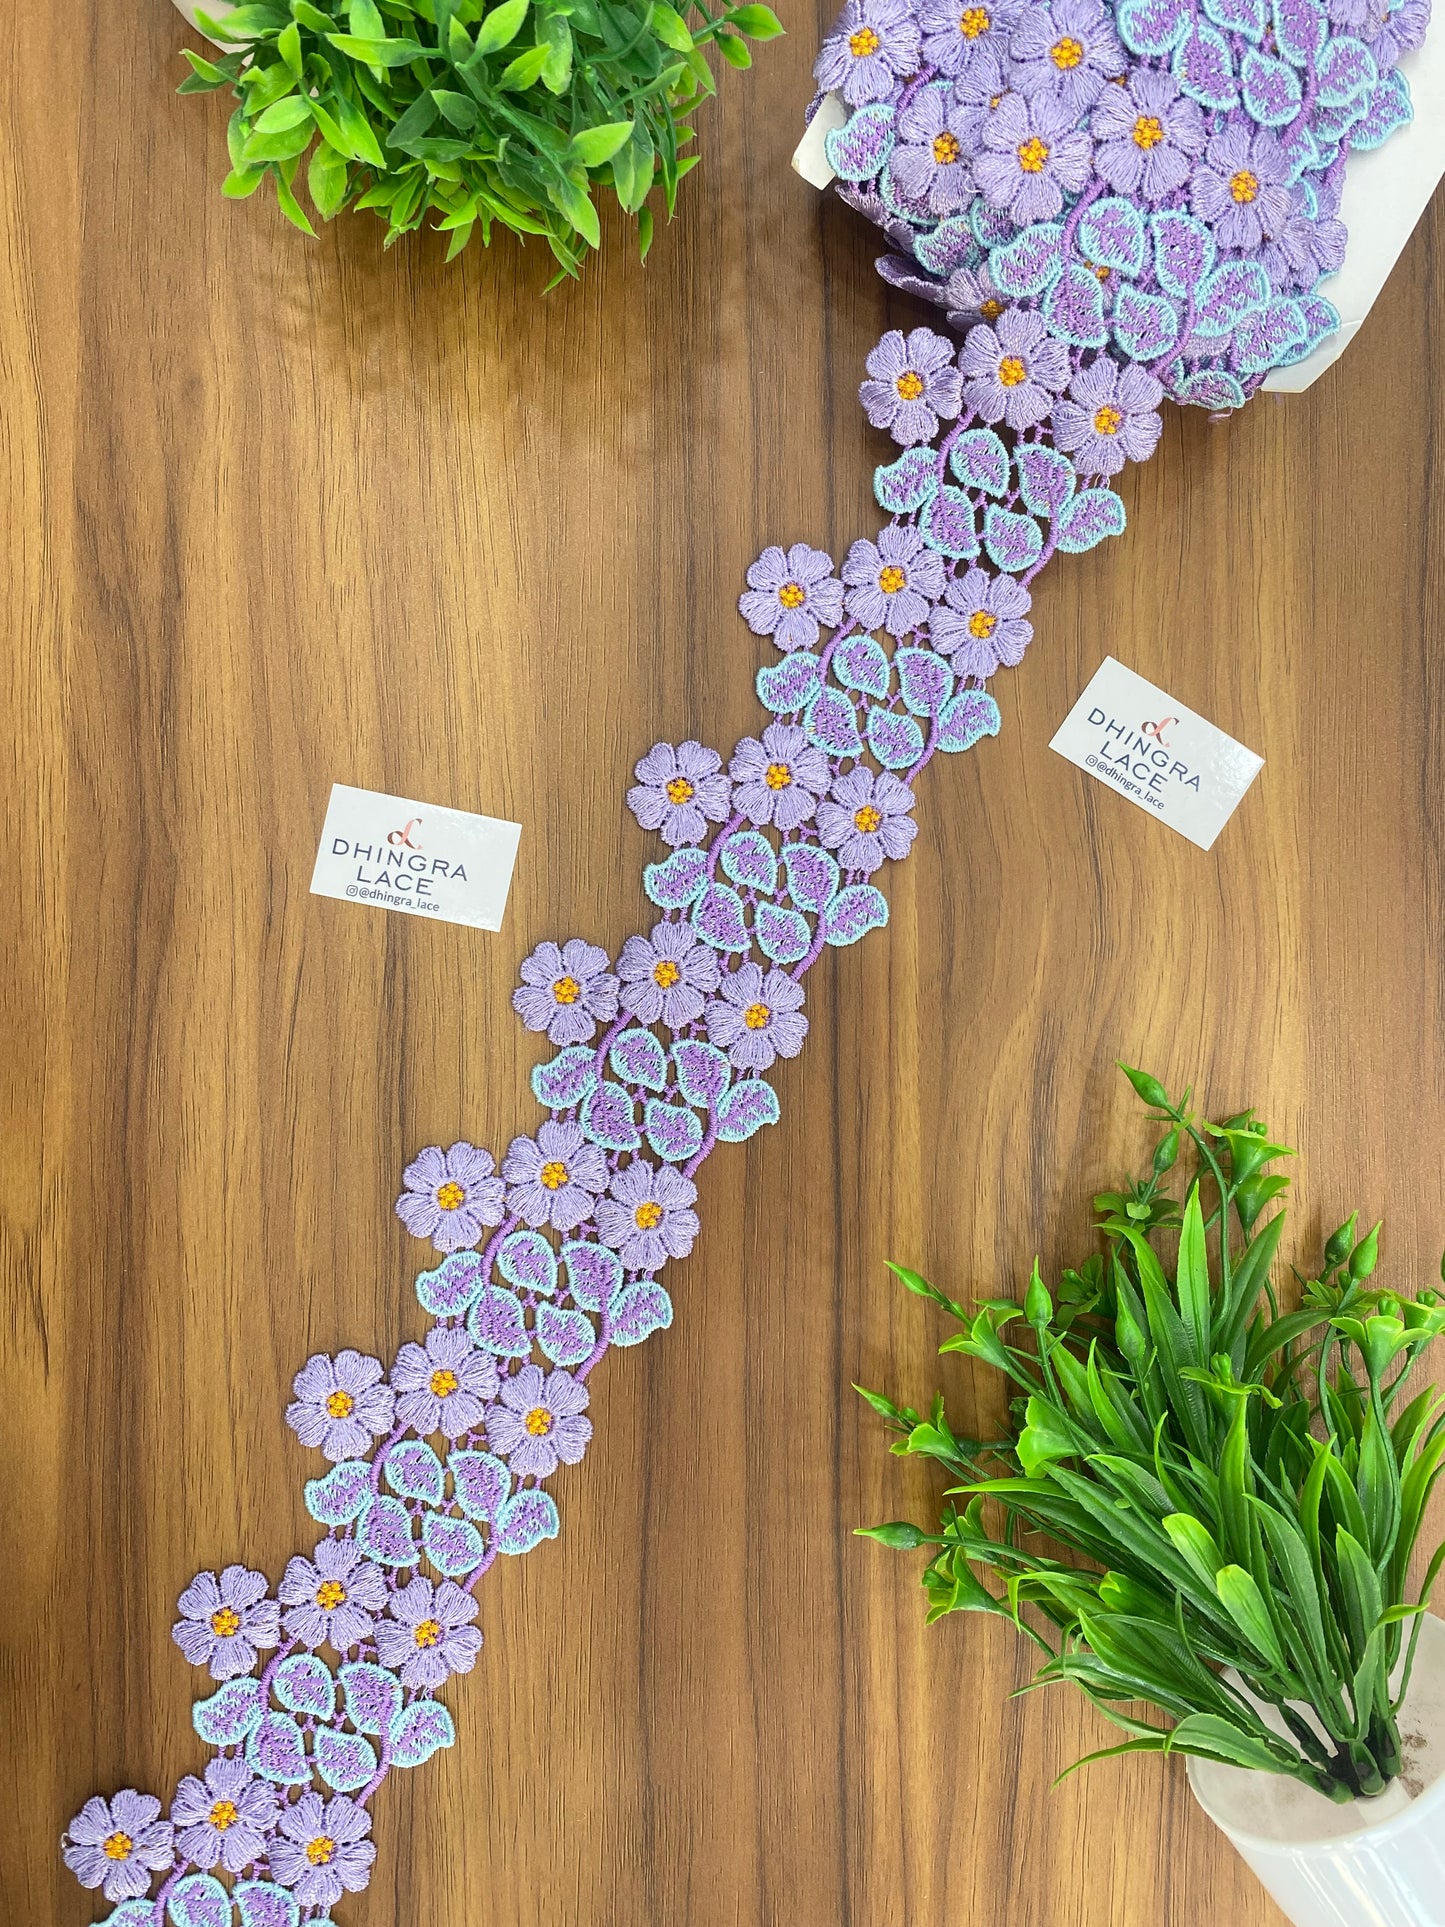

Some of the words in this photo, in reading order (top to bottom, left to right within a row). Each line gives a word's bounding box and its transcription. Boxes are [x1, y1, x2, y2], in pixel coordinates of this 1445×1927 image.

[1087, 707, 1200, 793] DHINGRA
[1099, 740, 1169, 793] LACE
[1096, 761, 1165, 810] @dhingra_lace
[332, 838, 468, 882] DHINGRA
[356, 865, 434, 896] LACE
[358, 887, 440, 912] @dhingra_lace
